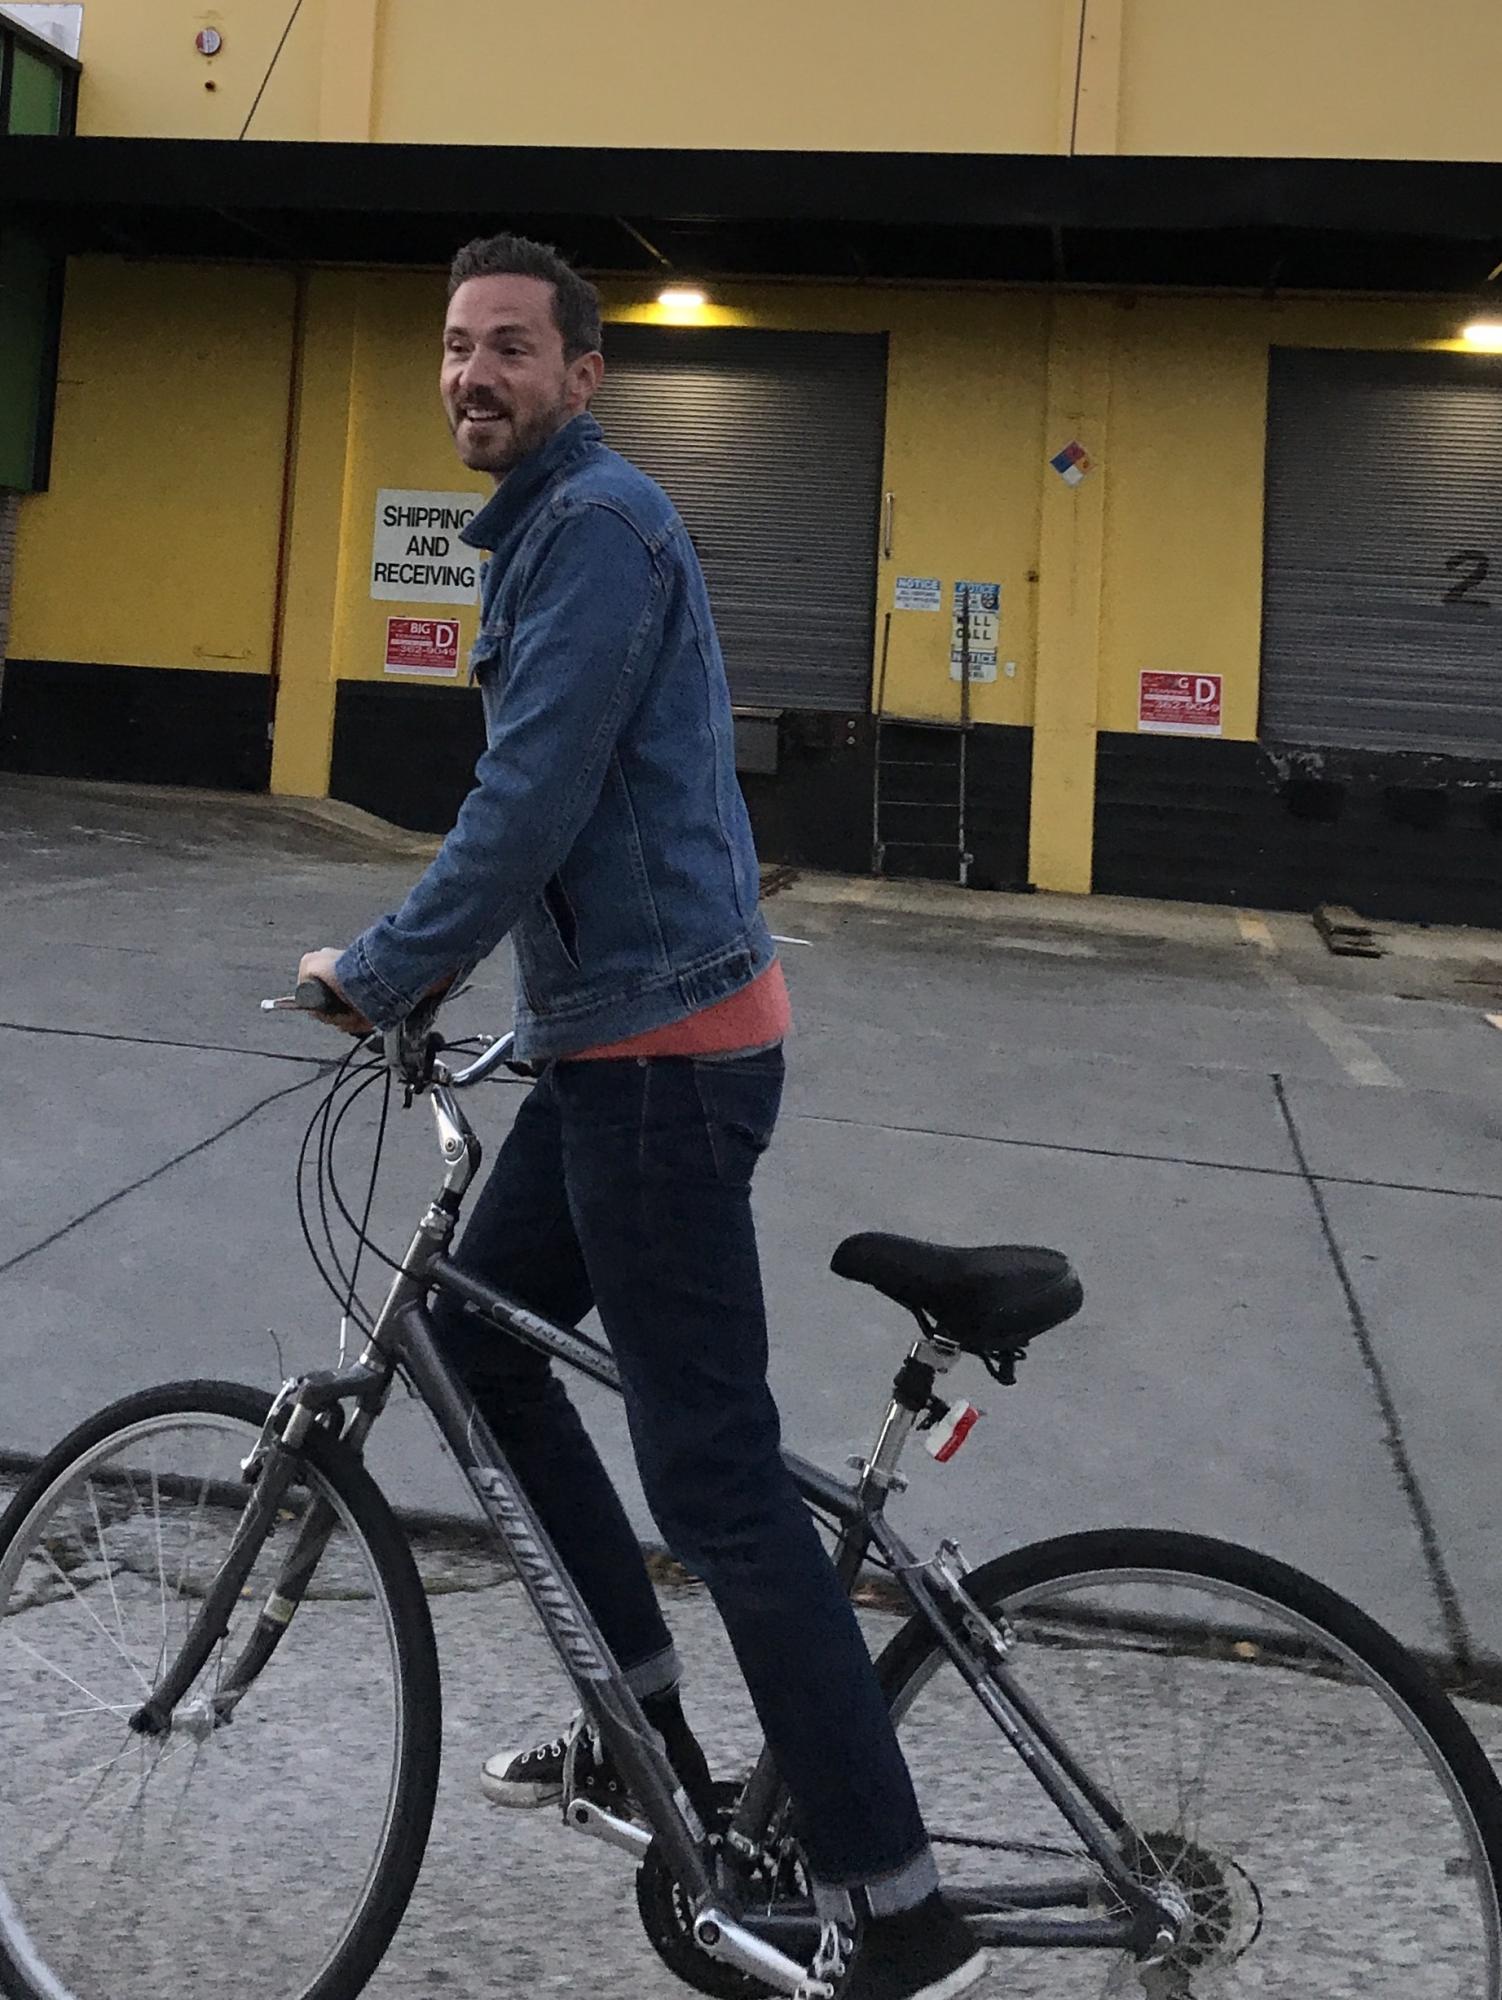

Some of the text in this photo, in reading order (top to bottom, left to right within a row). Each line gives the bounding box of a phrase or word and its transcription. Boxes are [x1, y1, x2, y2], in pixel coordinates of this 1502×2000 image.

[383, 505, 475, 529] SHIPPING
[406, 535, 449, 557] AND
[374, 562, 475, 587] RECEIVING
[898, 579, 938, 589] NOTICE
[1443, 552, 1490, 606] 2
[957, 615, 991, 627] WLL
[411, 622, 430, 634] BIG
[436, 624, 454, 647] D
[956, 628, 991, 640] CLL
[953, 652, 996, 664] NTICE
[1195, 678, 1216, 703] D
